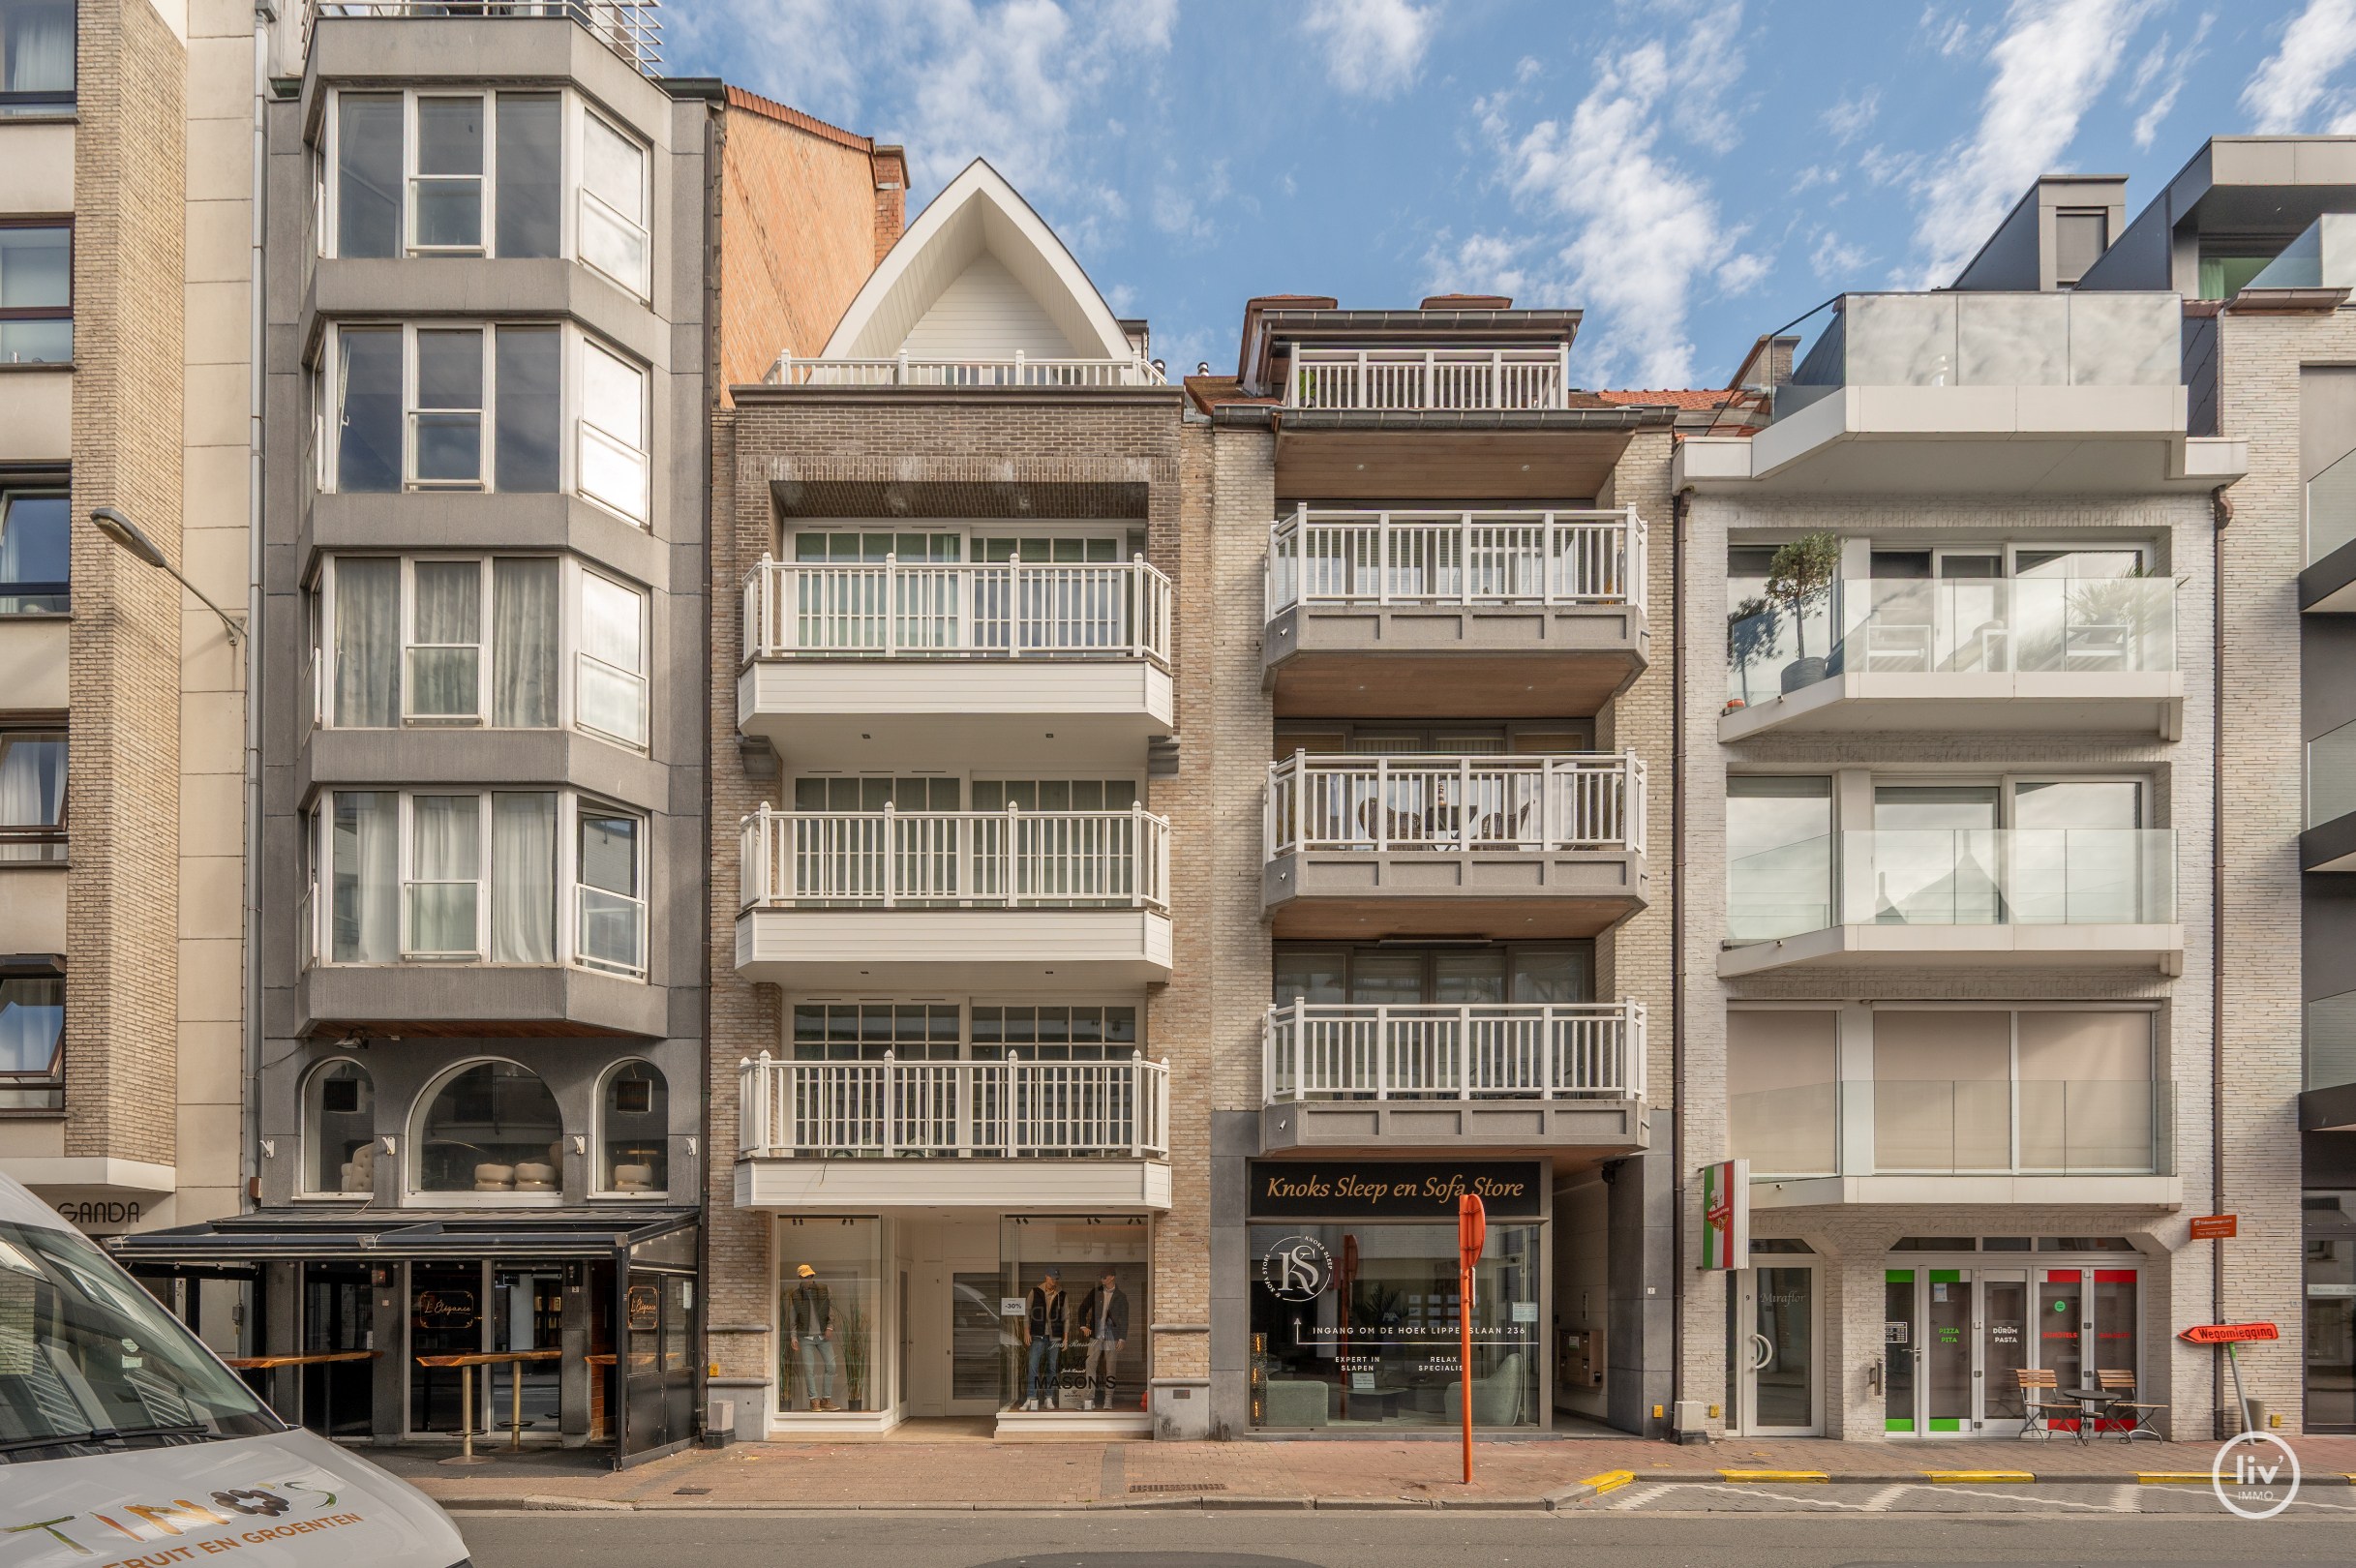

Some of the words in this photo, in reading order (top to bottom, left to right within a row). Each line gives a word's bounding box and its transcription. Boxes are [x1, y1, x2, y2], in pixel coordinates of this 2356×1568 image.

[1267, 1175, 1330, 1197] Knoks
[1334, 1175, 1388, 1204] Sleep
[1393, 1183, 1417, 1197] en
[1421, 1174, 1466, 1204] Sofa
[1470, 1177, 1525, 1197] Store
[57, 1201, 139, 1223] GANDA
[1262, 1253, 1271, 1275] STORE
[1760, 1290, 1806, 1308] Miraflor
[2197, 1328, 2273, 1342] Wegomlegging
[197, 1537, 242, 1554] EN
[241, 1513, 363, 1544] GROENTEN
